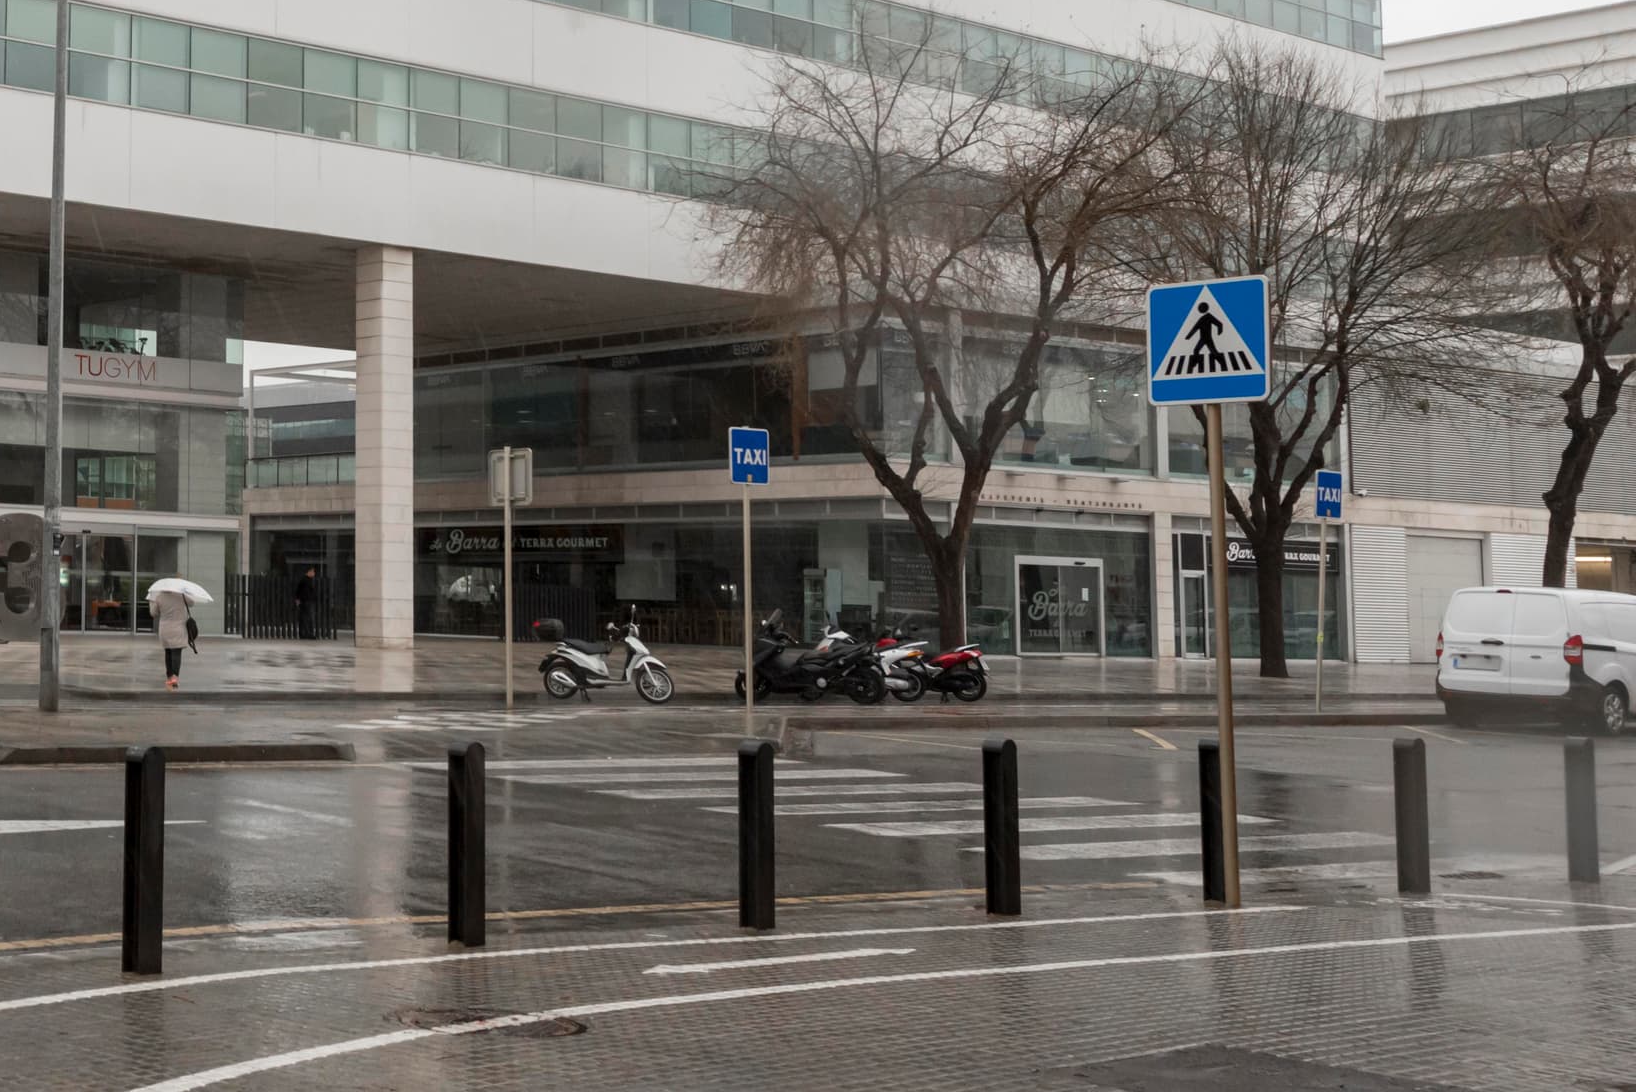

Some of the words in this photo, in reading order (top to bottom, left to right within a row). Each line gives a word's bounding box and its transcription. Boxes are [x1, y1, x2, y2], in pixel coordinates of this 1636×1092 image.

[74, 353, 157, 381] TUGYM
[734, 447, 767, 466] TAXI
[1318, 486, 1341, 503] TAXI
[446, 529, 500, 554] Barra
[520, 537, 555, 549] TERRA
[556, 536, 609, 548] GOURMET
[1226, 542, 1256, 561] Bar
